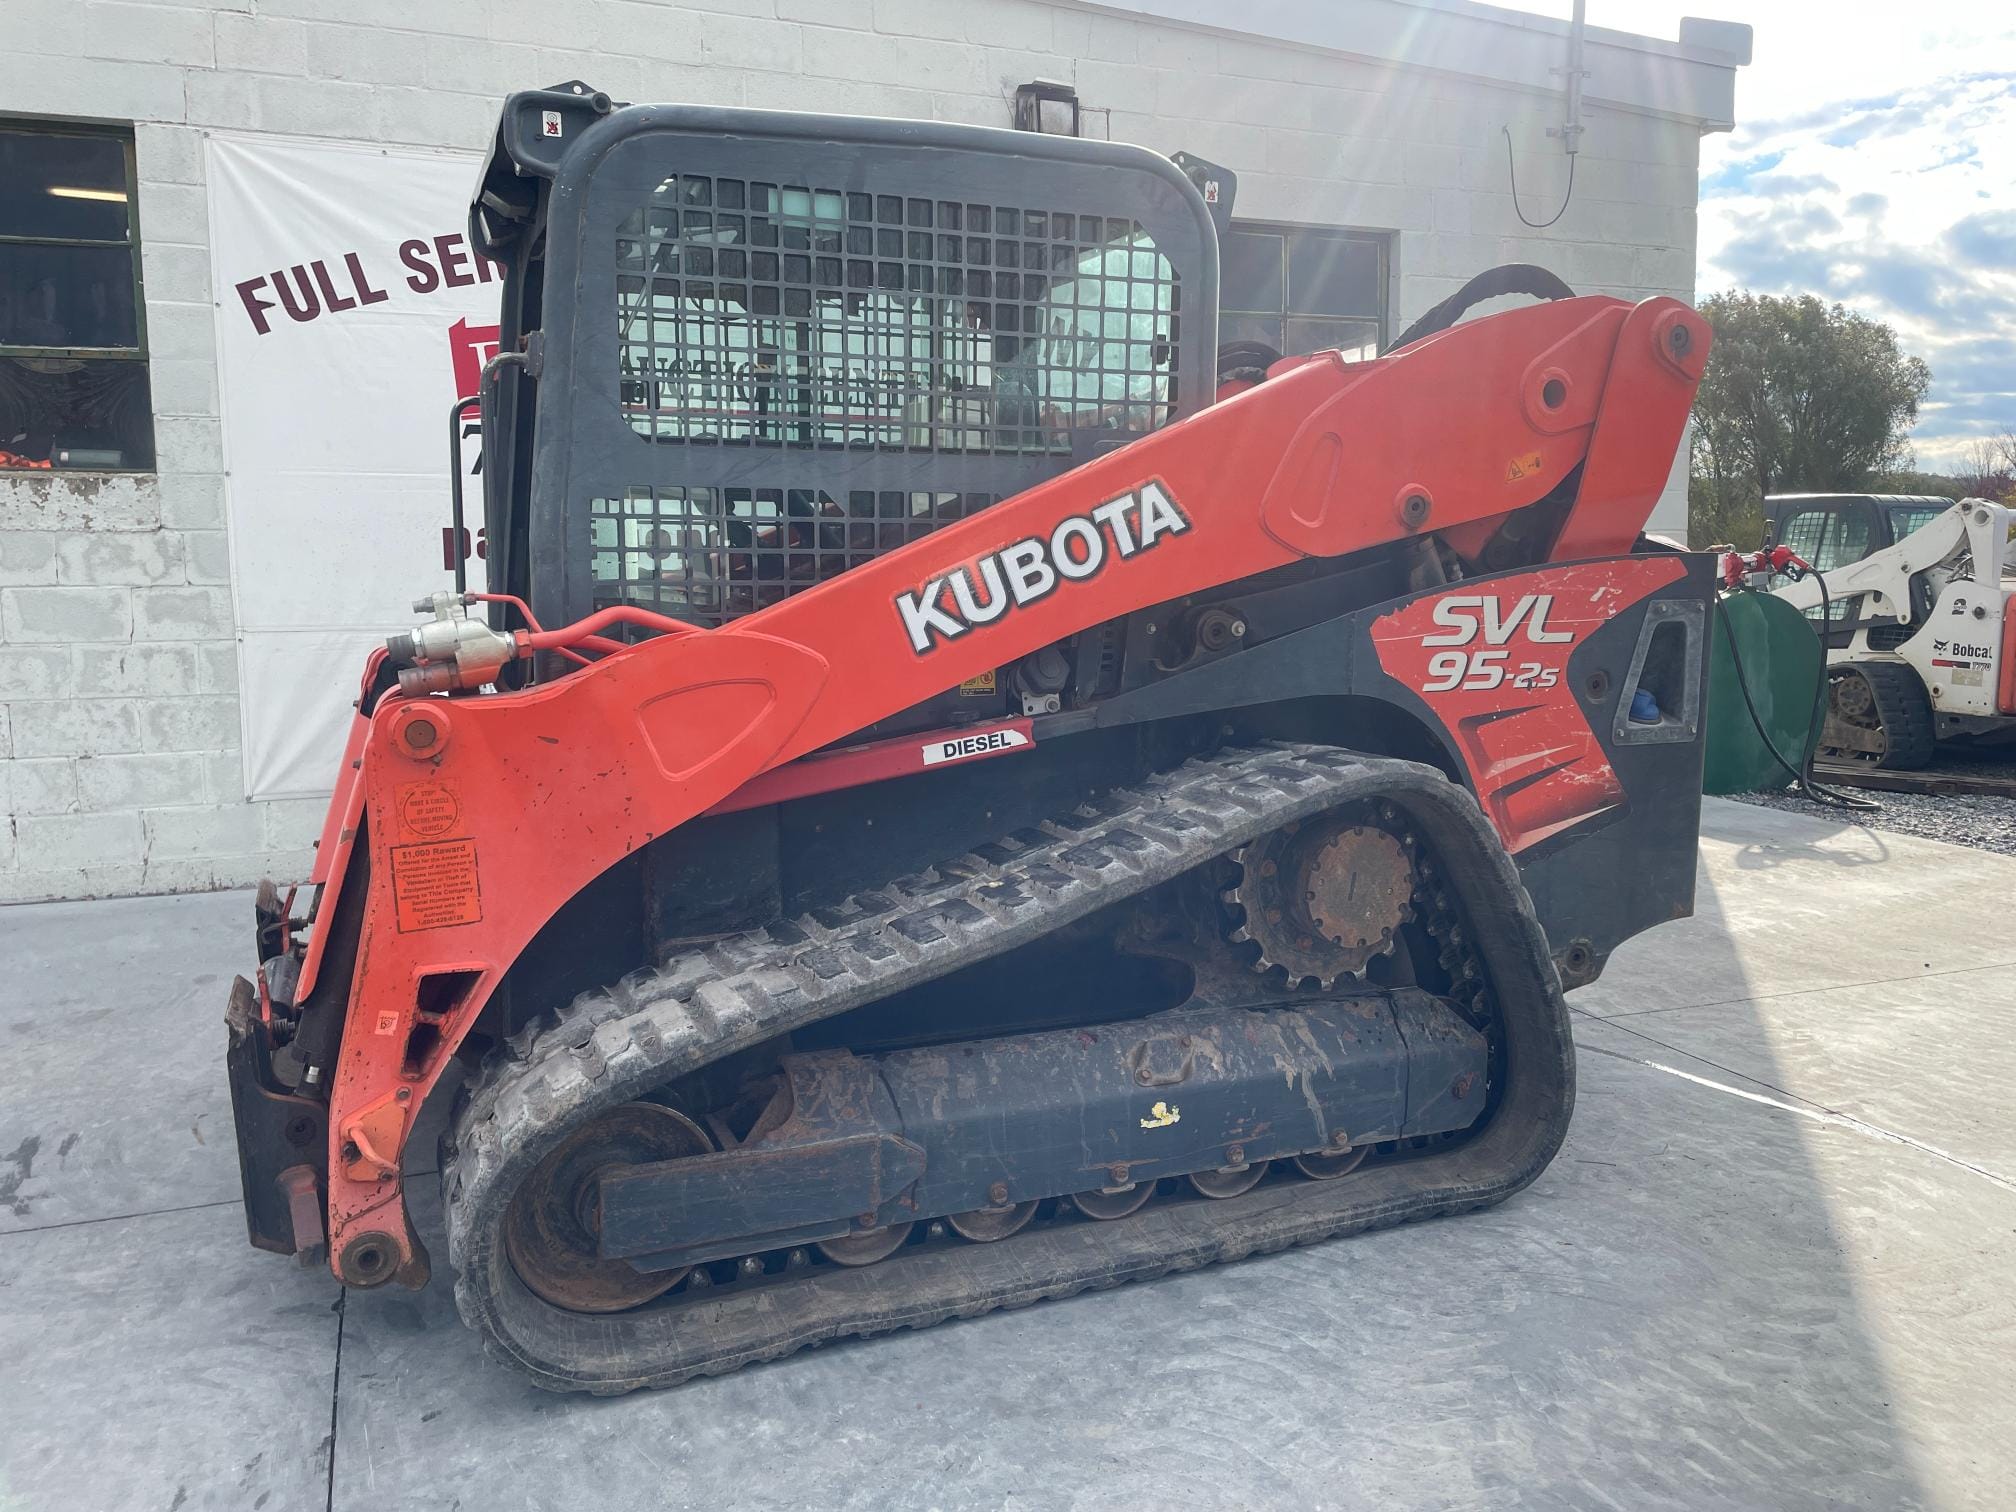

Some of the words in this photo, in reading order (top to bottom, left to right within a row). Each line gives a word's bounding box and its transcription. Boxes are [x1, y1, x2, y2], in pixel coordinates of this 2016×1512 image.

[235, 252, 389, 336] FULL
[896, 481, 1190, 654] KUBOTA
[1422, 594, 1575, 647] SVL
[943, 732, 1011, 759] DIESEL
[433, 845, 466, 856] Reward
